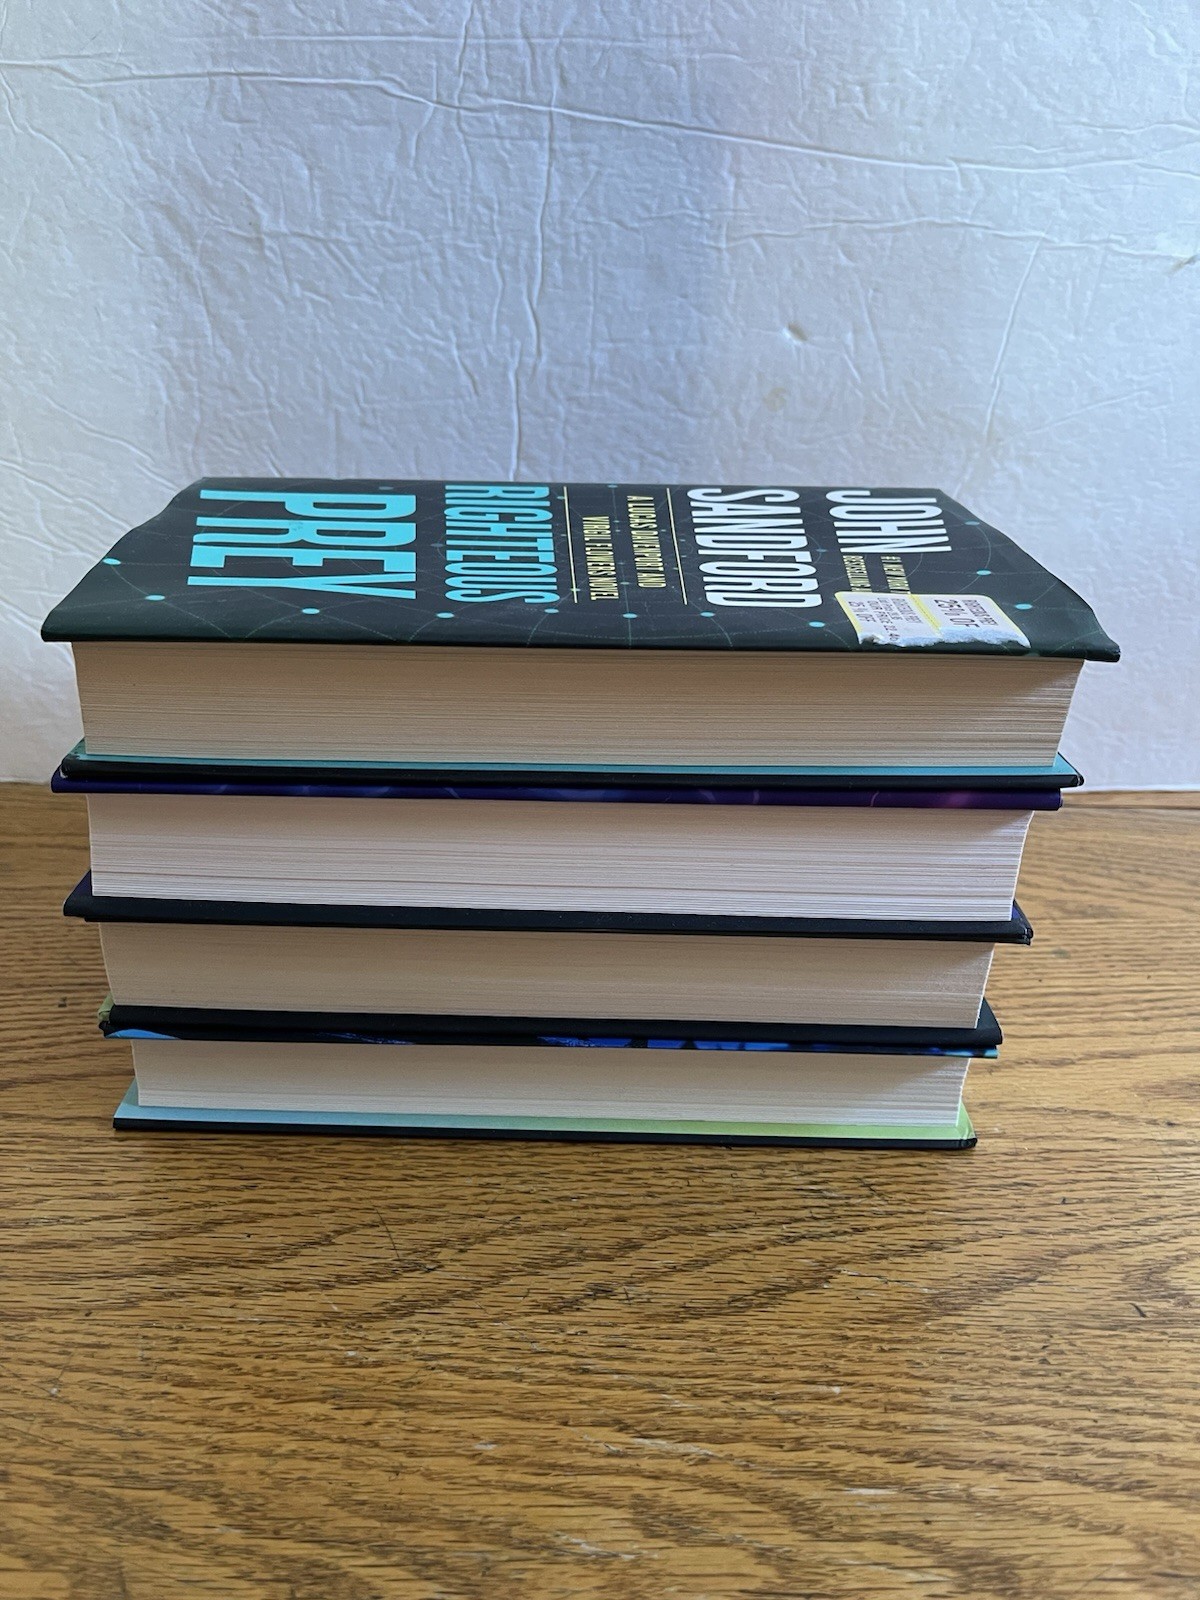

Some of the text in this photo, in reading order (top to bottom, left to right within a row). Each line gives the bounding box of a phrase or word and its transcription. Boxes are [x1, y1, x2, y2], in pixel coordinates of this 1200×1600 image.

[628, 503, 658, 529] LUCAS
[826, 489, 952, 553] JOHN
[187, 489, 416, 600] PREY
[444, 485, 560, 603] RIGHTEOUS
[582, 516, 619, 600] VIRGIL FLOWERS NOVEL
[631, 530, 664, 571] DAVENPORT
[687, 488, 822, 608] SANDFORD
[637, 573, 667, 588] AND
[843, 555, 871, 587] BESTSELLING
[882, 564, 906, 576] NEW
[886, 576, 910, 590] YORK
[934, 599, 967, 616] 25%
